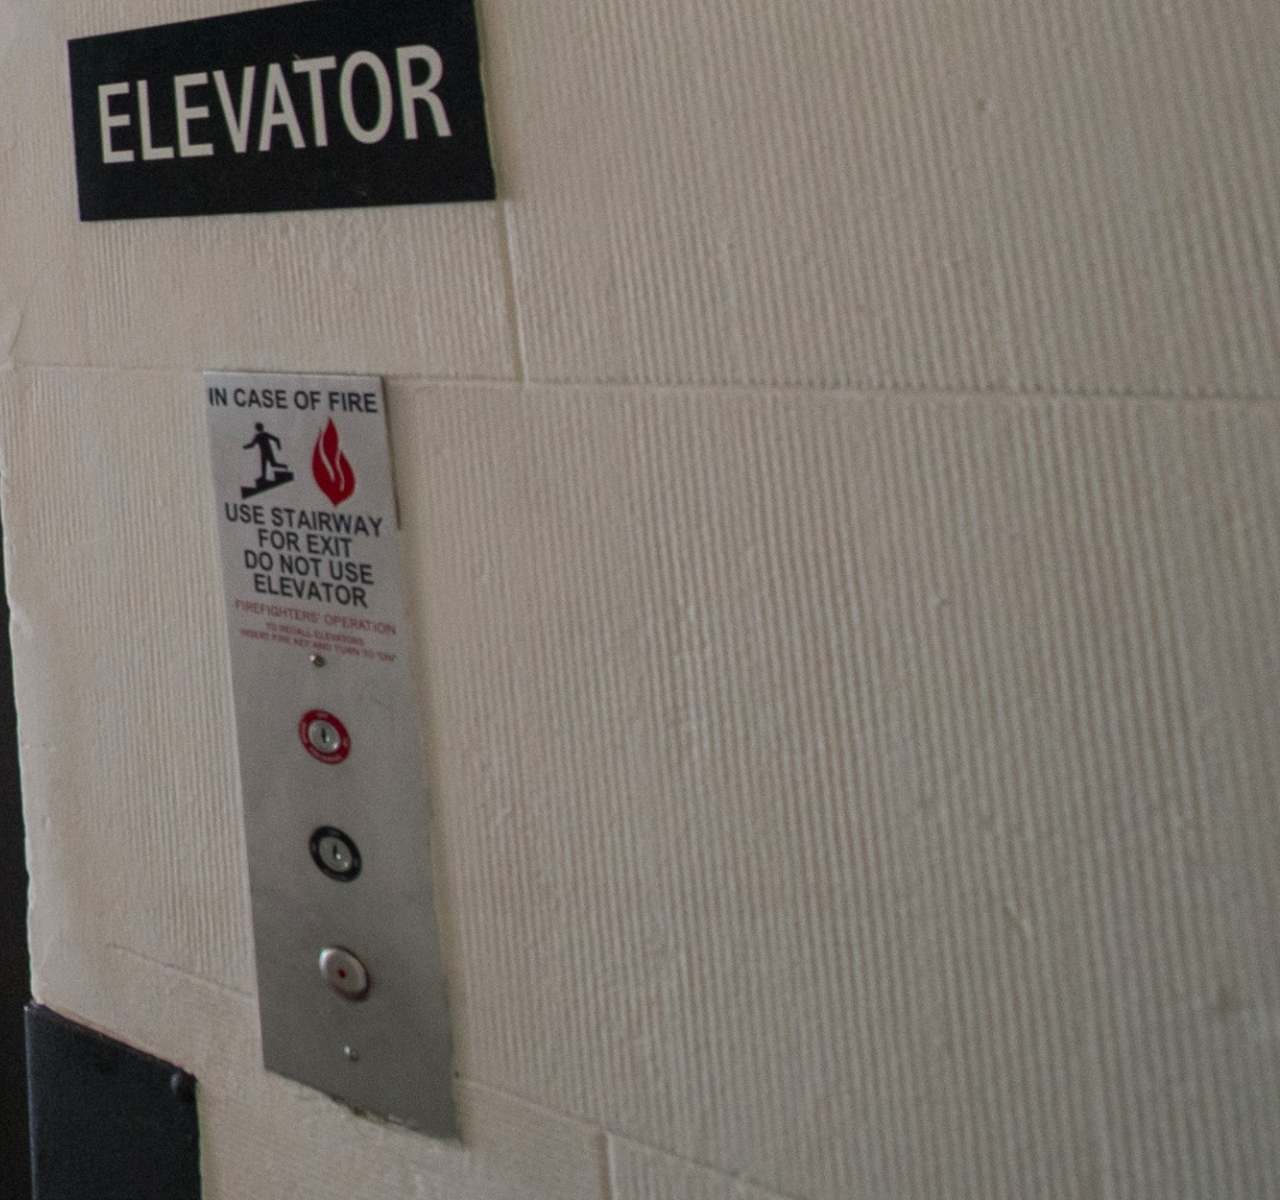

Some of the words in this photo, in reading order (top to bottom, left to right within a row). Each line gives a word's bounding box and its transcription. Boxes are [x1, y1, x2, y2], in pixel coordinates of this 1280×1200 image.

[97, 43, 452, 165] ELEVATOR
[208, 387, 228, 407] IN
[234, 388, 288, 409] CASE
[294, 390, 321, 411] OF
[328, 392, 378, 413] FIRE
[225, 503, 265, 525] USE
[271, 508, 383, 537] STAIRWAY
[258, 528, 300, 553] FOR
[307, 535, 352, 558] EXIT
[244, 550, 273, 571] DO
[280, 556, 322, 577] NOT
[330, 562, 375, 585] USE
[254, 574, 368, 608] ELEVATOR
[324, 614, 397, 636] OPERATION
